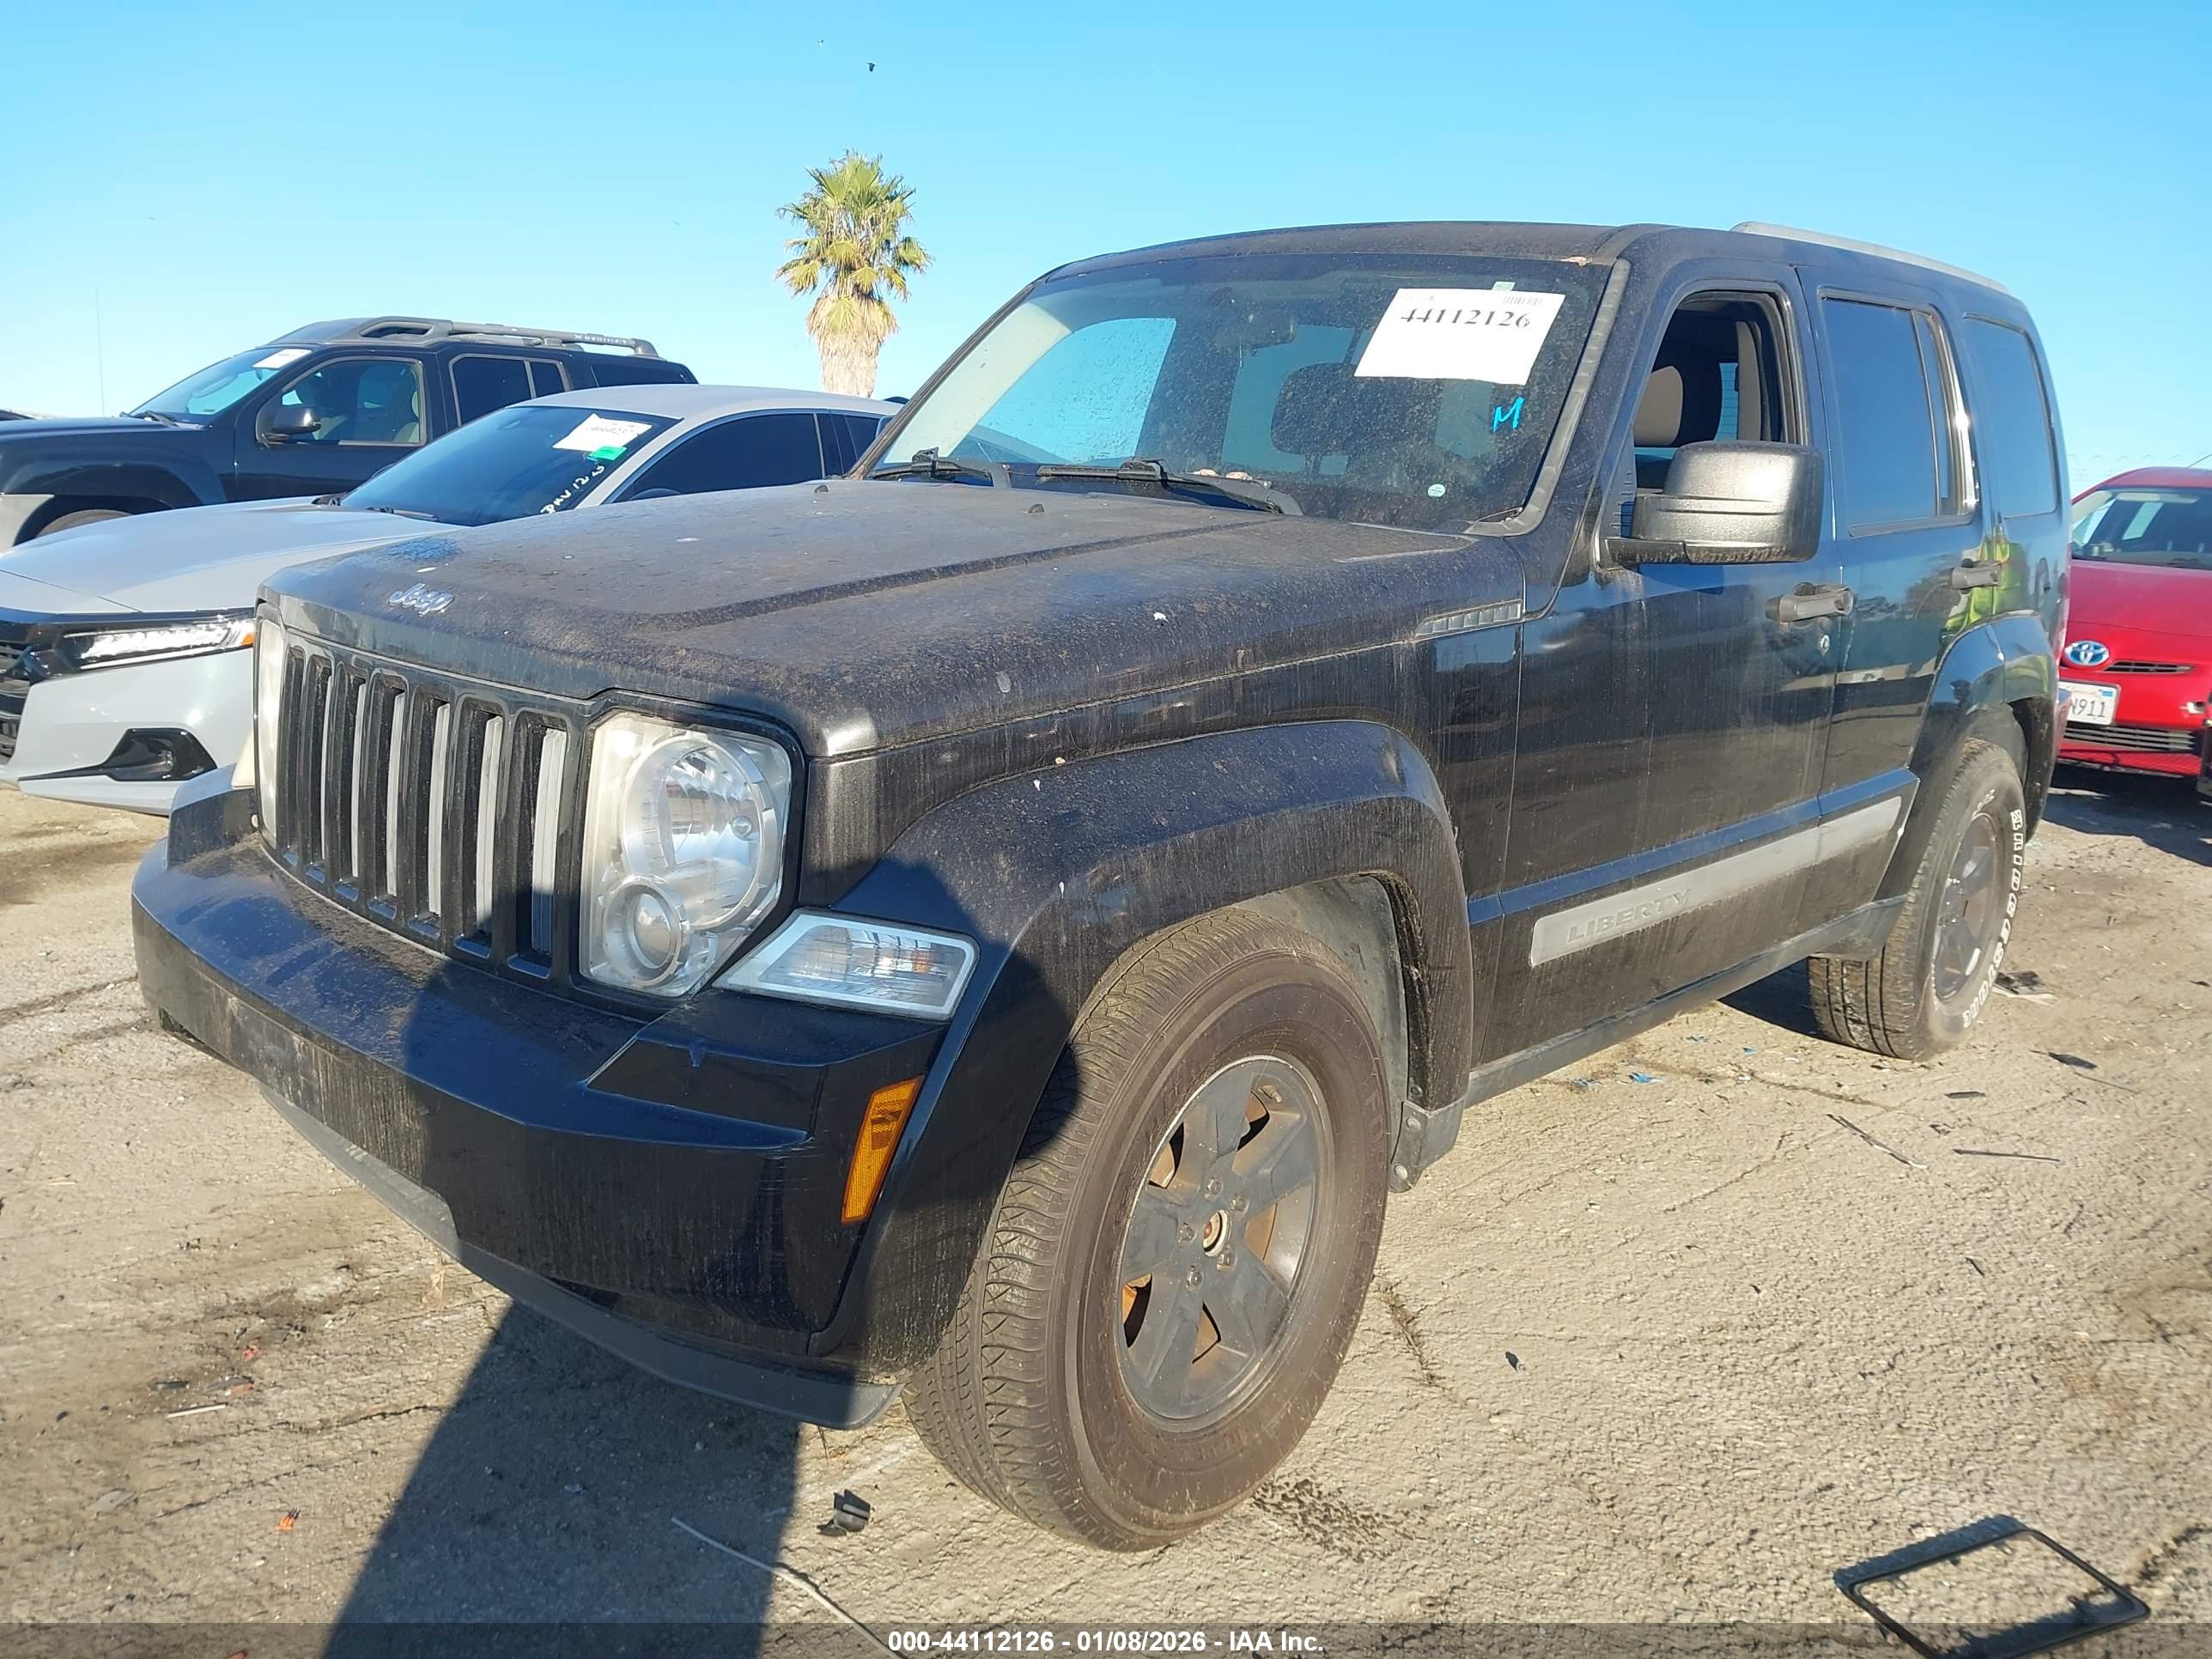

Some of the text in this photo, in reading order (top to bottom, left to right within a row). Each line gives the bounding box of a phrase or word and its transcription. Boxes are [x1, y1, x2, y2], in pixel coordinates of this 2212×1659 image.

[1401, 308, 1531, 329] 44112126
[1491, 397, 1525, 433] M
[389, 583, 454, 618] Jeep
[1566, 888, 1691, 944] LIBERTY
